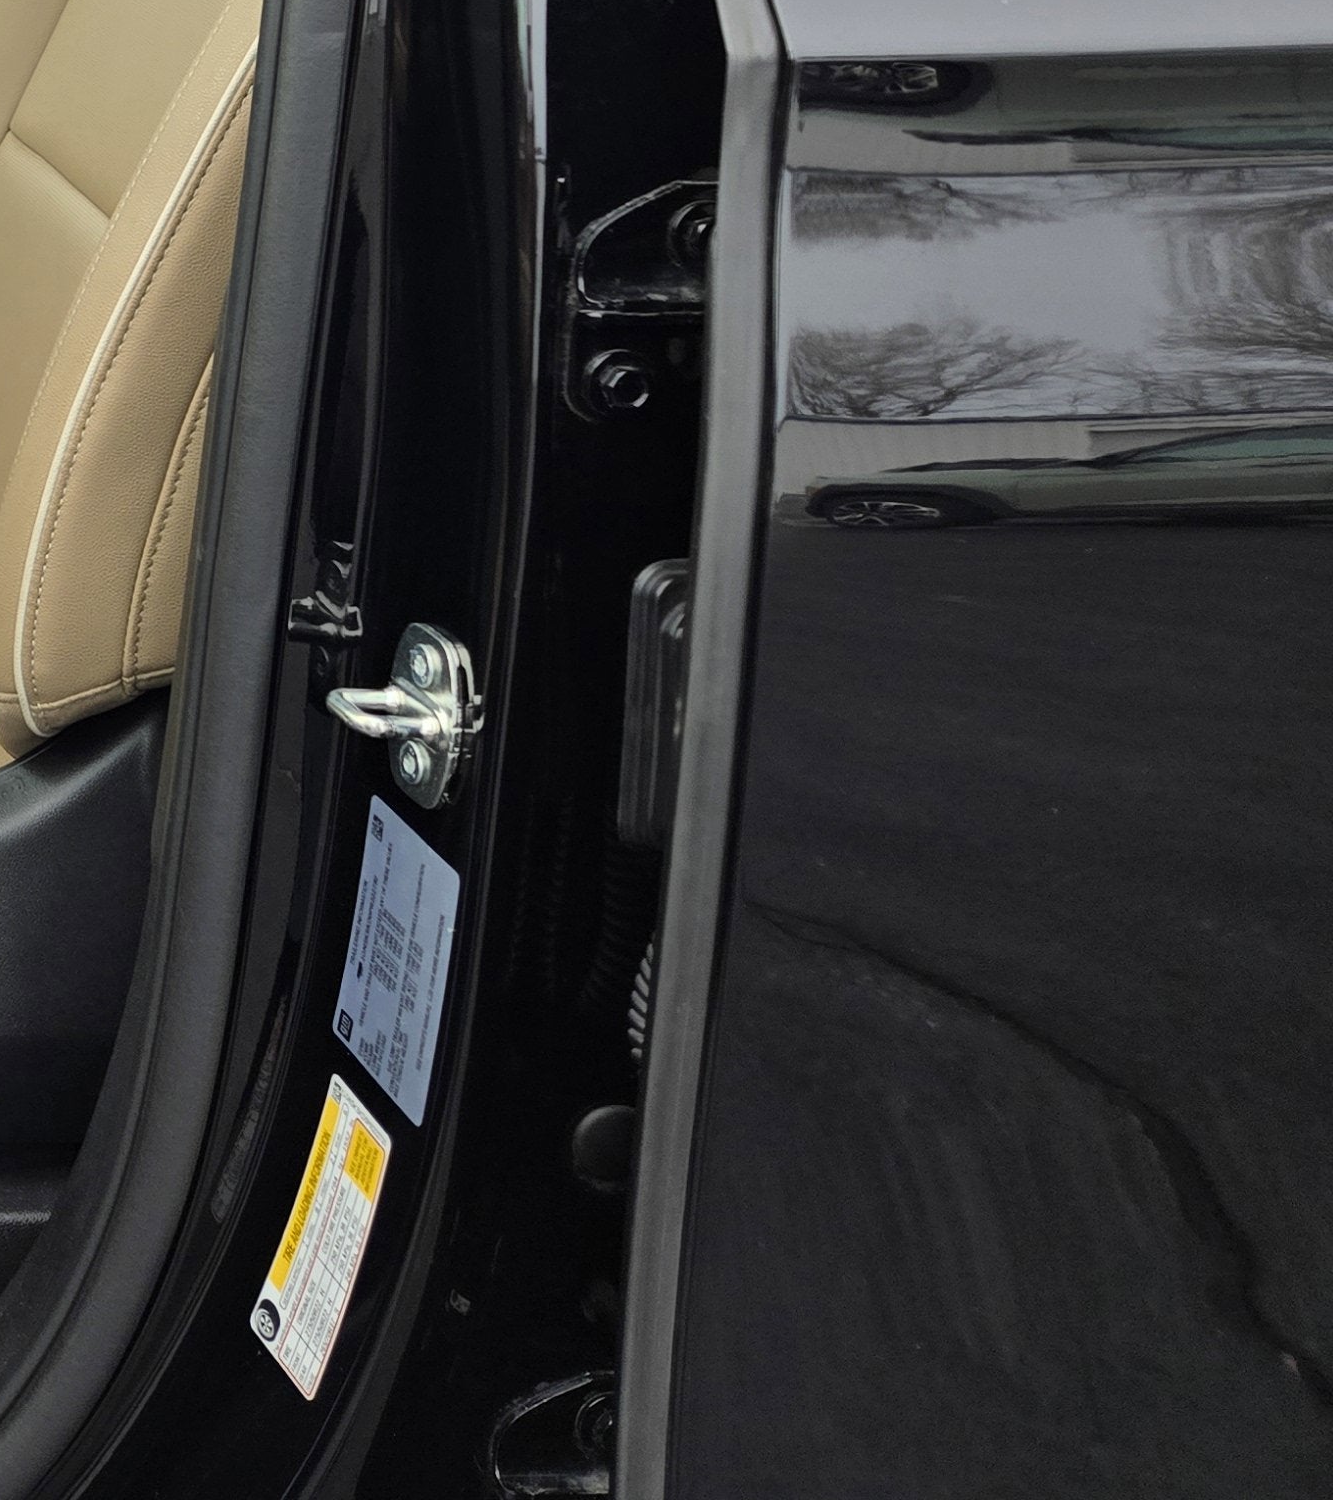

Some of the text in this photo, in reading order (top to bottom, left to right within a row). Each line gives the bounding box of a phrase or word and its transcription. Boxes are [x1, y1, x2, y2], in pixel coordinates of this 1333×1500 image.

[283, 1130, 332, 1264] TIRE AND LOADING INFORMATION
